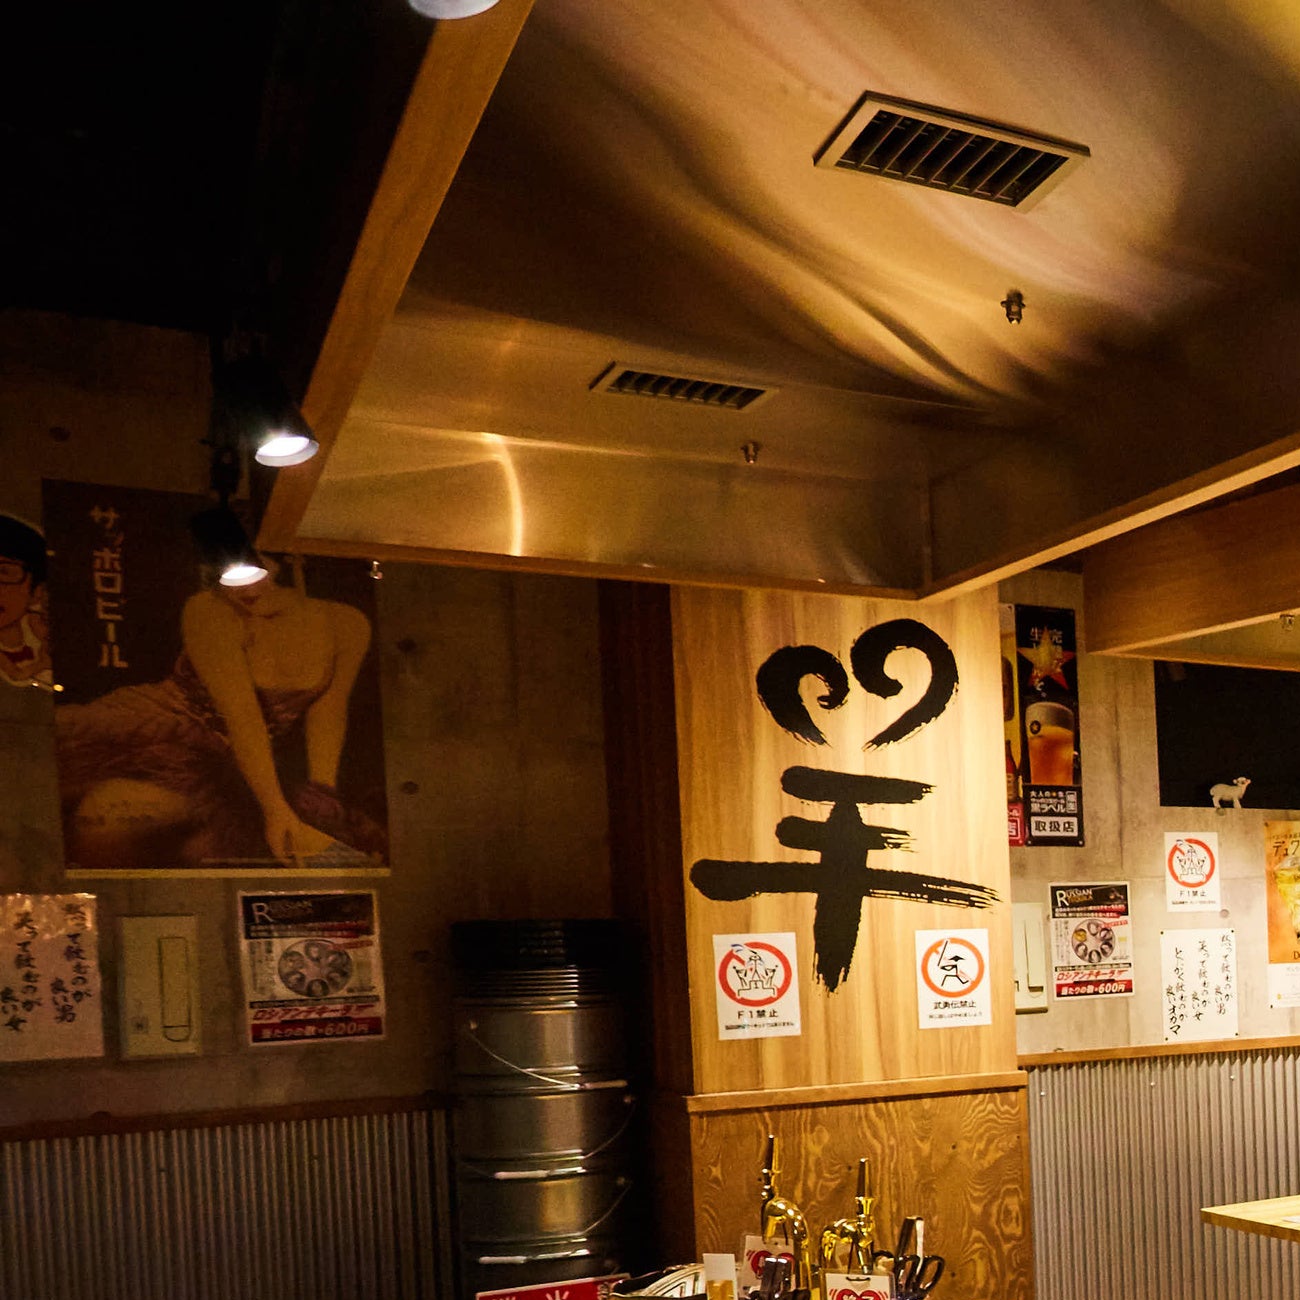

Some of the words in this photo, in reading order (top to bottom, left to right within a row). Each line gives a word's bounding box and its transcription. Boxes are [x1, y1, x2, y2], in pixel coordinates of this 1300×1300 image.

[89, 505, 128, 668] サッポロビール
[1034, 820, 1075, 834] 取扱店
